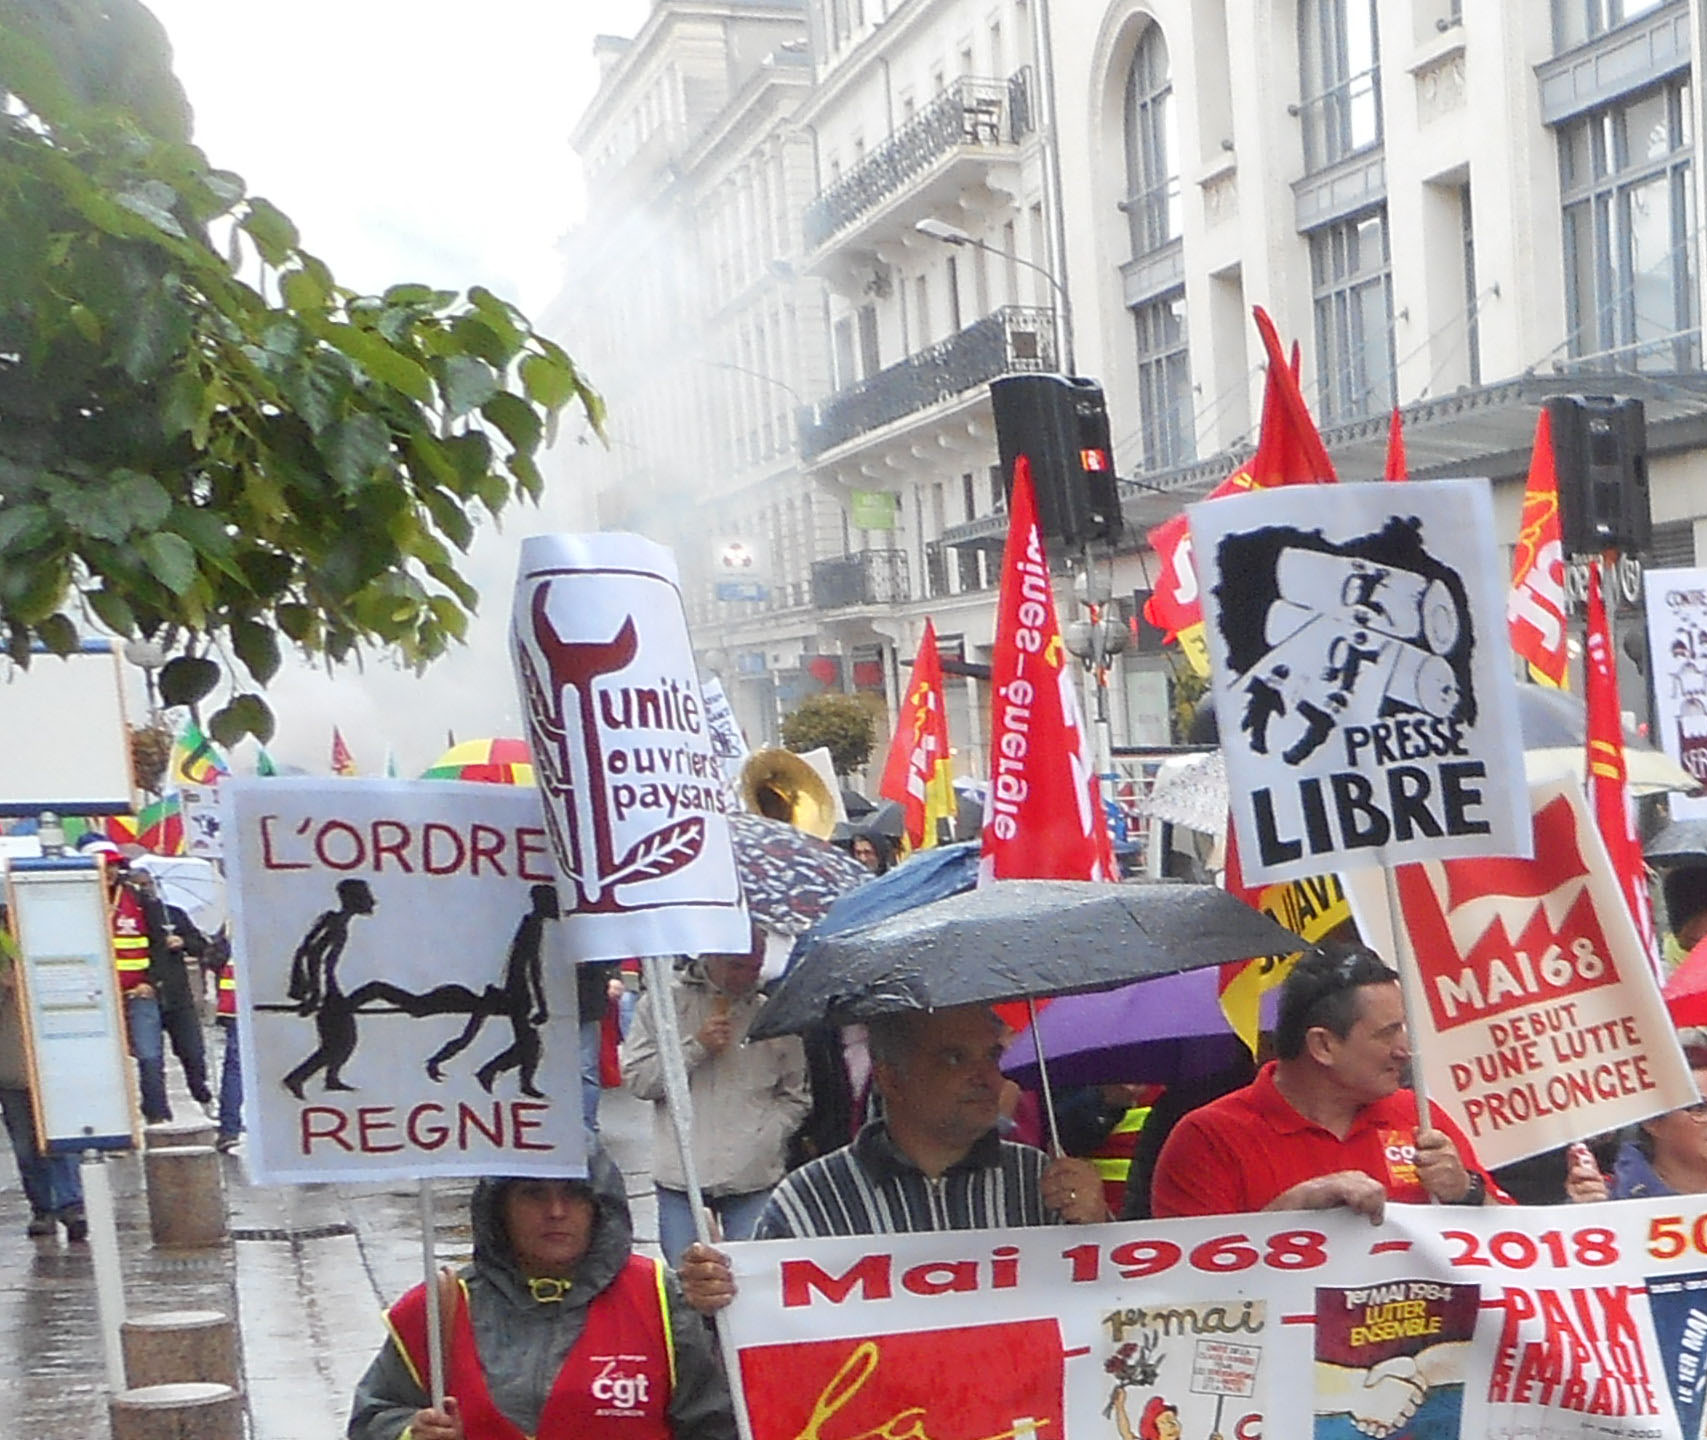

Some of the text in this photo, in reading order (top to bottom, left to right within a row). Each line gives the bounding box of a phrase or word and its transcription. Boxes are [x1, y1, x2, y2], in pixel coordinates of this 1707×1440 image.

[598, 678, 702, 734] unité
[608, 741, 720, 780] ouvriers
[1344, 716, 1471, 768] PRESSE
[612, 782, 727, 821] paysans
[1251, 761, 1492, 868] LIBRE
[260, 814, 558, 882] L'ORDRE
[1434, 936, 1606, 1018] MAI 68
[1488, 1002, 1579, 1049] DEBUT
[1550, 1015, 1643, 1065] LUTTE
[301, 1101, 557, 1156] REGNE
[1385, 1146, 1416, 1166] cg
[779, 1247, 1020, 1307] Mai
[1061, 1230, 1329, 1283] 1968
[1441, 1229, 1620, 1268] 2018
[1102, 1301, 1265, 1342] 1er mai
[1350, 1316, 1443, 1347] ENSEMBLE
[1365, 1300, 1426, 1324] LUTTER
[1498, 1286, 1638, 1350] PAIX
[592, 1373, 649, 1408] cgt
